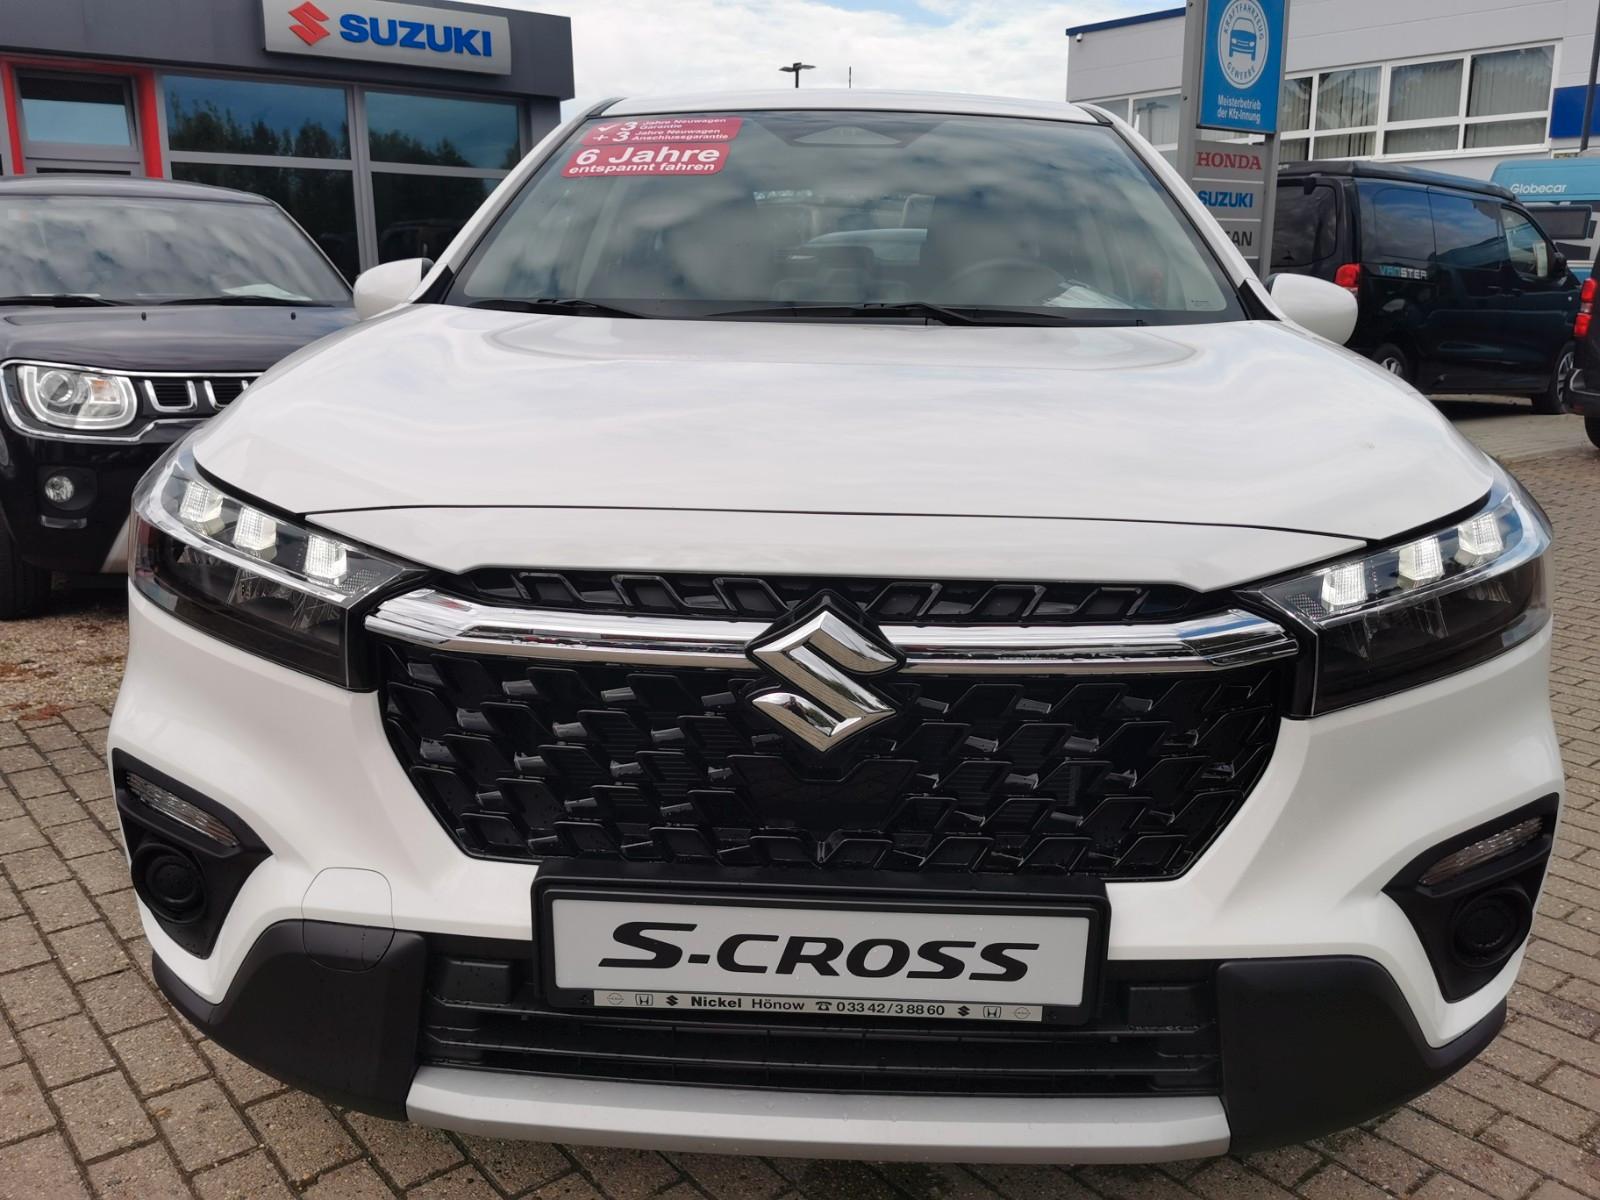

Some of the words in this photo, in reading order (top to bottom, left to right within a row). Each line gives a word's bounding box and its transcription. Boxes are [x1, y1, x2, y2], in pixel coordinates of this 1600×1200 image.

[339, 13, 493, 57] SUZUKI
[1217, 94, 1262, 110] Meisterbetrieb
[1217, 107, 1229, 119] der
[1228, 108, 1261, 124] Kfz-Innung
[620, 121, 638, 131] 3
[612, 131, 631, 142] 3
[576, 148, 600, 165] 6
[608, 146, 720, 163] Jahre
[1196, 152, 1262, 170] HONDA
[569, 161, 657, 174] entspannt
[659, 162, 715, 171] fahren
[1510, 183, 1567, 194] Globecar
[1198, 190, 1254, 209] SUZUKI
[598, 921, 1040, 982] S-CROSS
[691, 995, 742, 1009] Nickel
[751, 997, 805, 1012] Hönow
